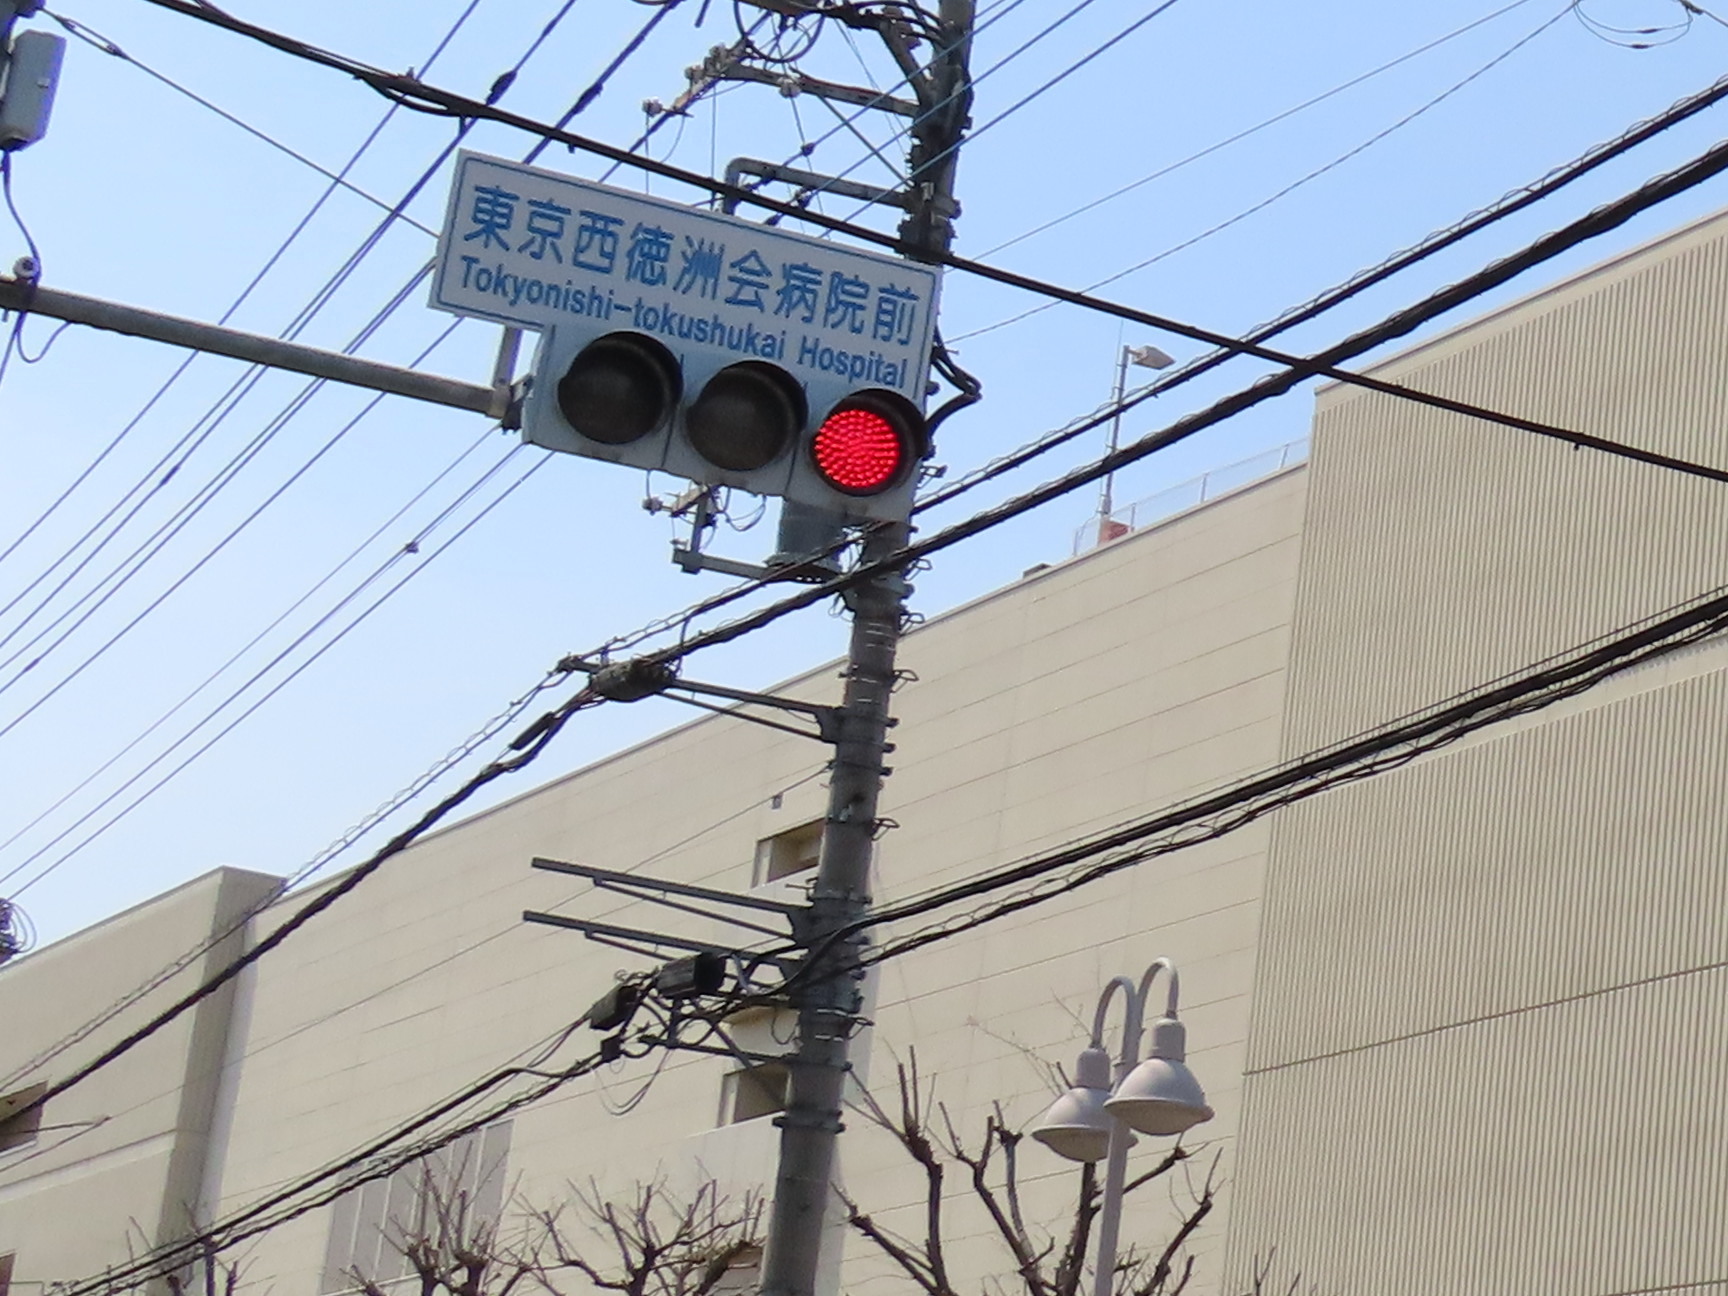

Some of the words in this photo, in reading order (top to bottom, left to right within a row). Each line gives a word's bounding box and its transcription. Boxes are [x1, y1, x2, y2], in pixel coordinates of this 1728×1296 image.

[460, 255, 786, 360] Tokyonishi-tokushukai
[796, 336, 908, 390] Hospital
[462, 184, 921, 346] 東京西徳洲会病院前
